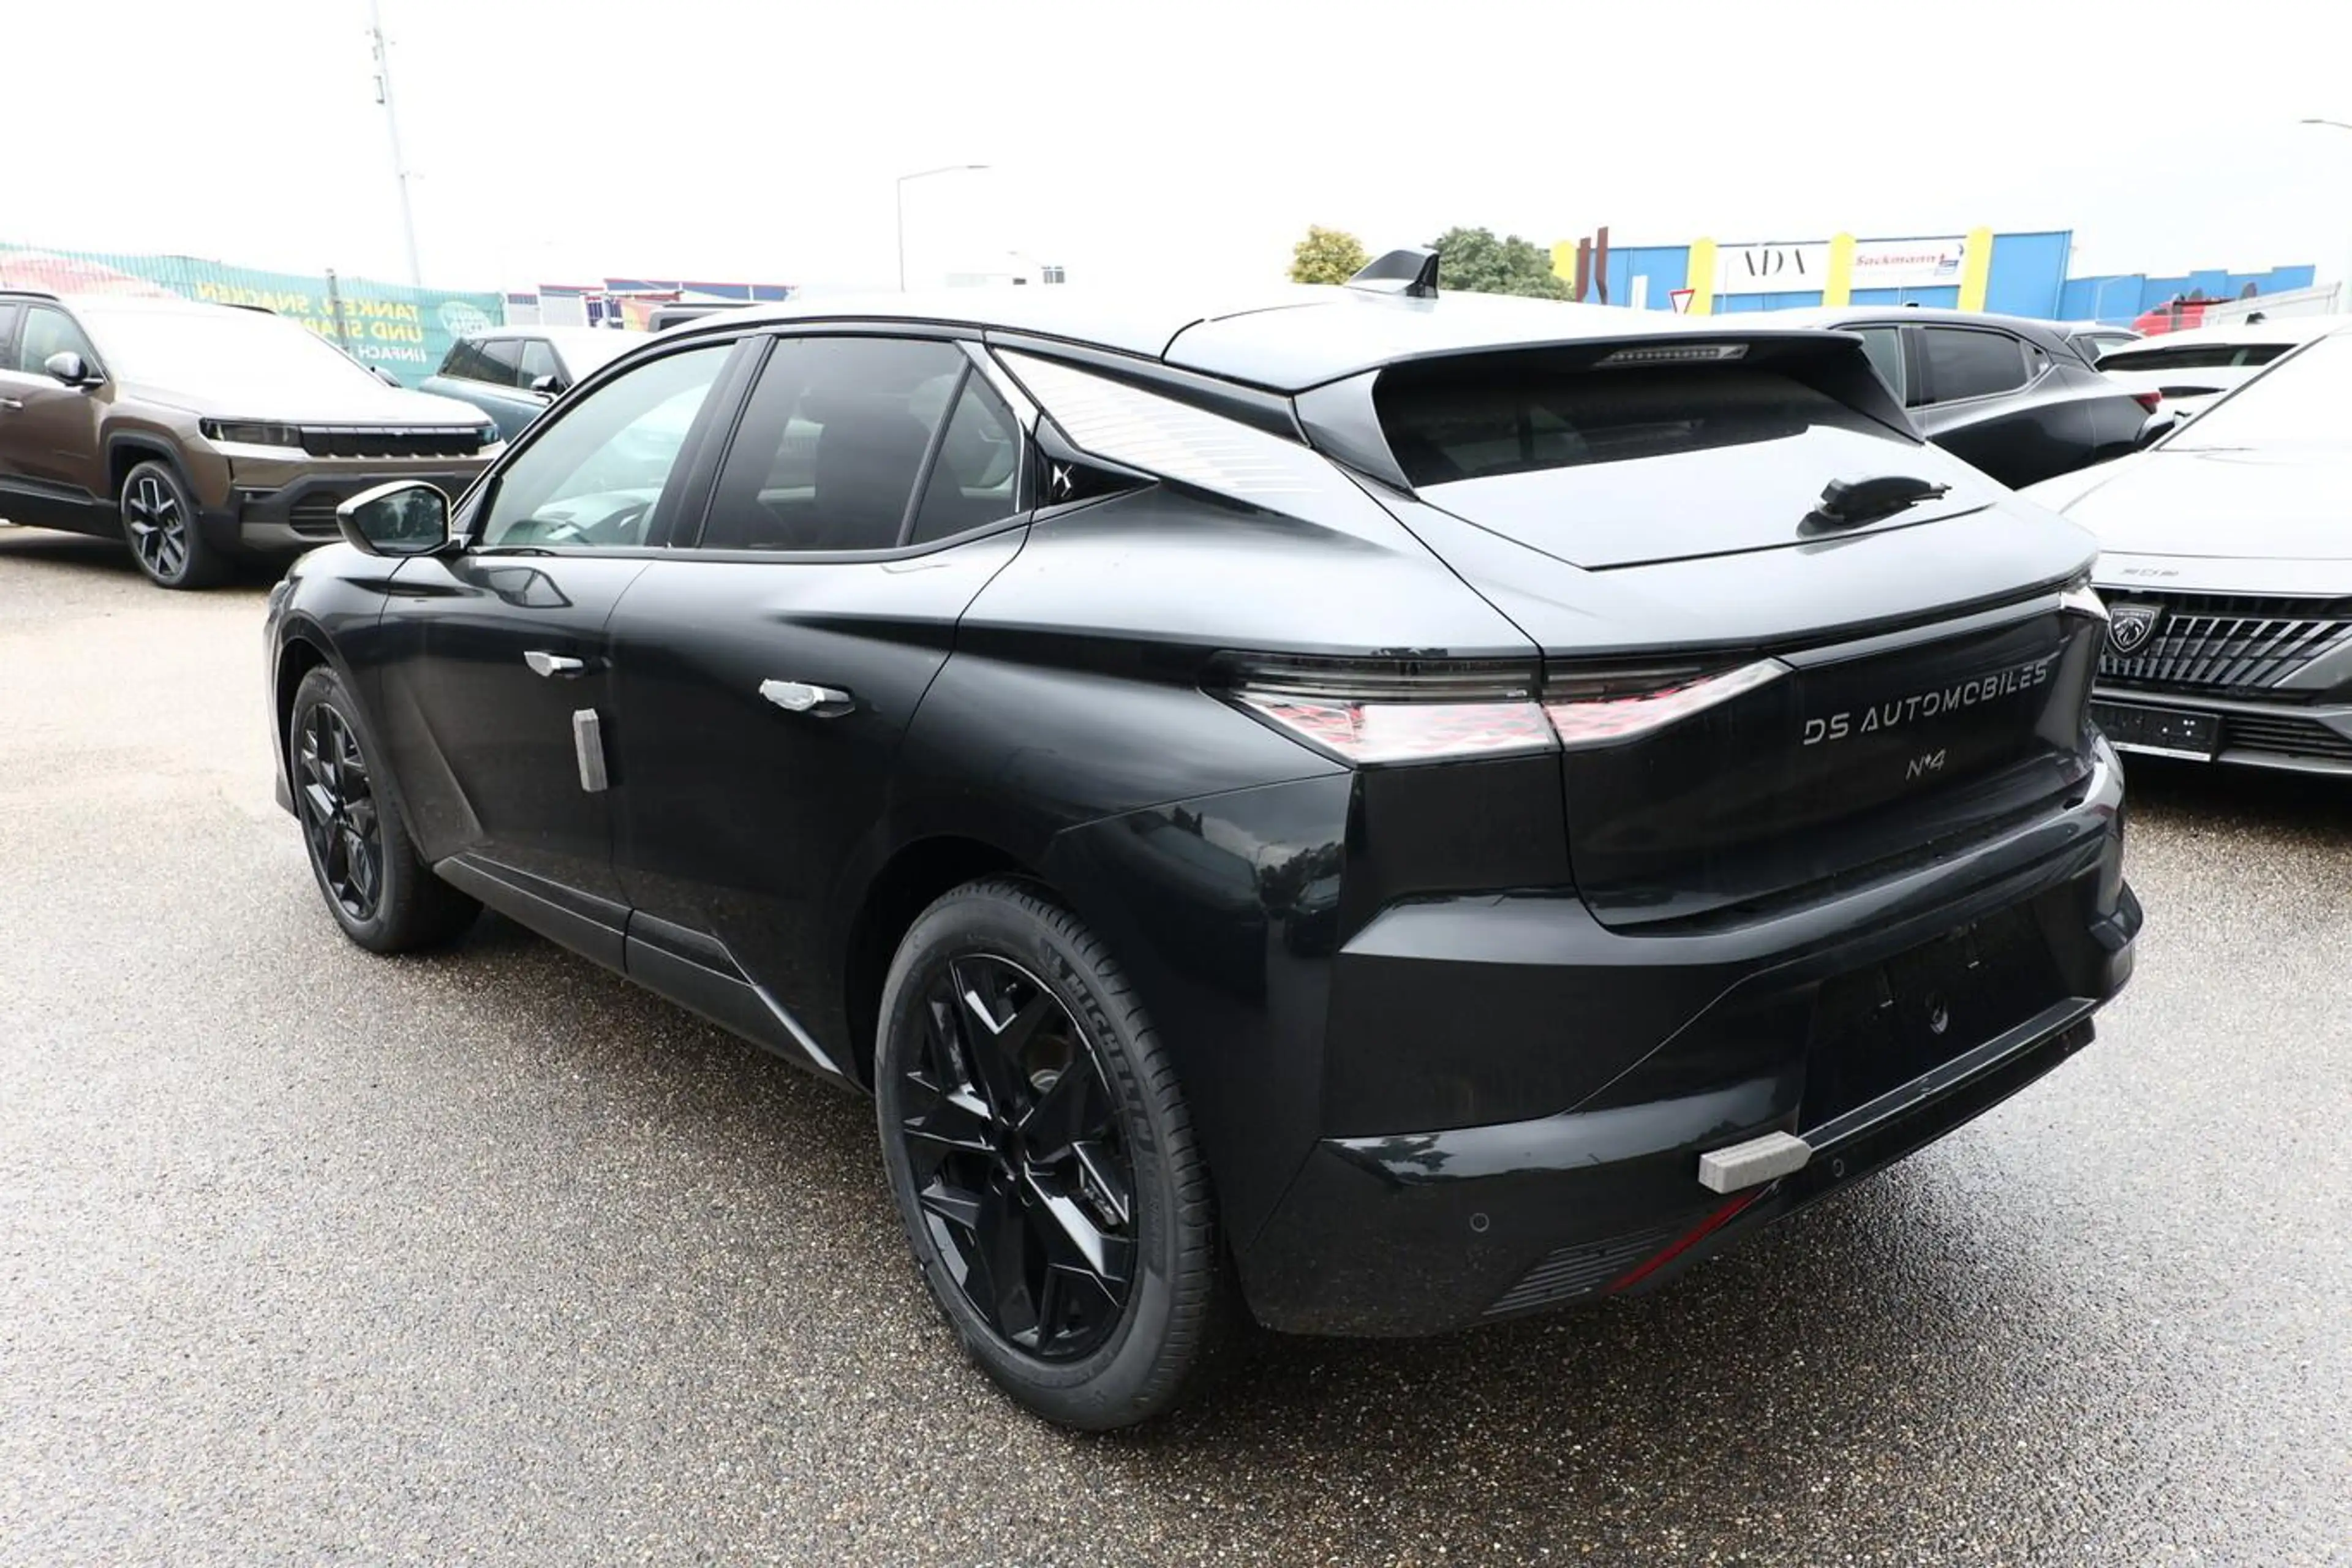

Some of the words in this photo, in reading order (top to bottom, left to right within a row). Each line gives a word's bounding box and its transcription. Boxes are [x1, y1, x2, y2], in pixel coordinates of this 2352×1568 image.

[1803, 712, 1850, 746] DS
[1861, 661, 2049, 733] AUTOMOBILES
[1064, 972, 1156, 1144] MICHELIN
